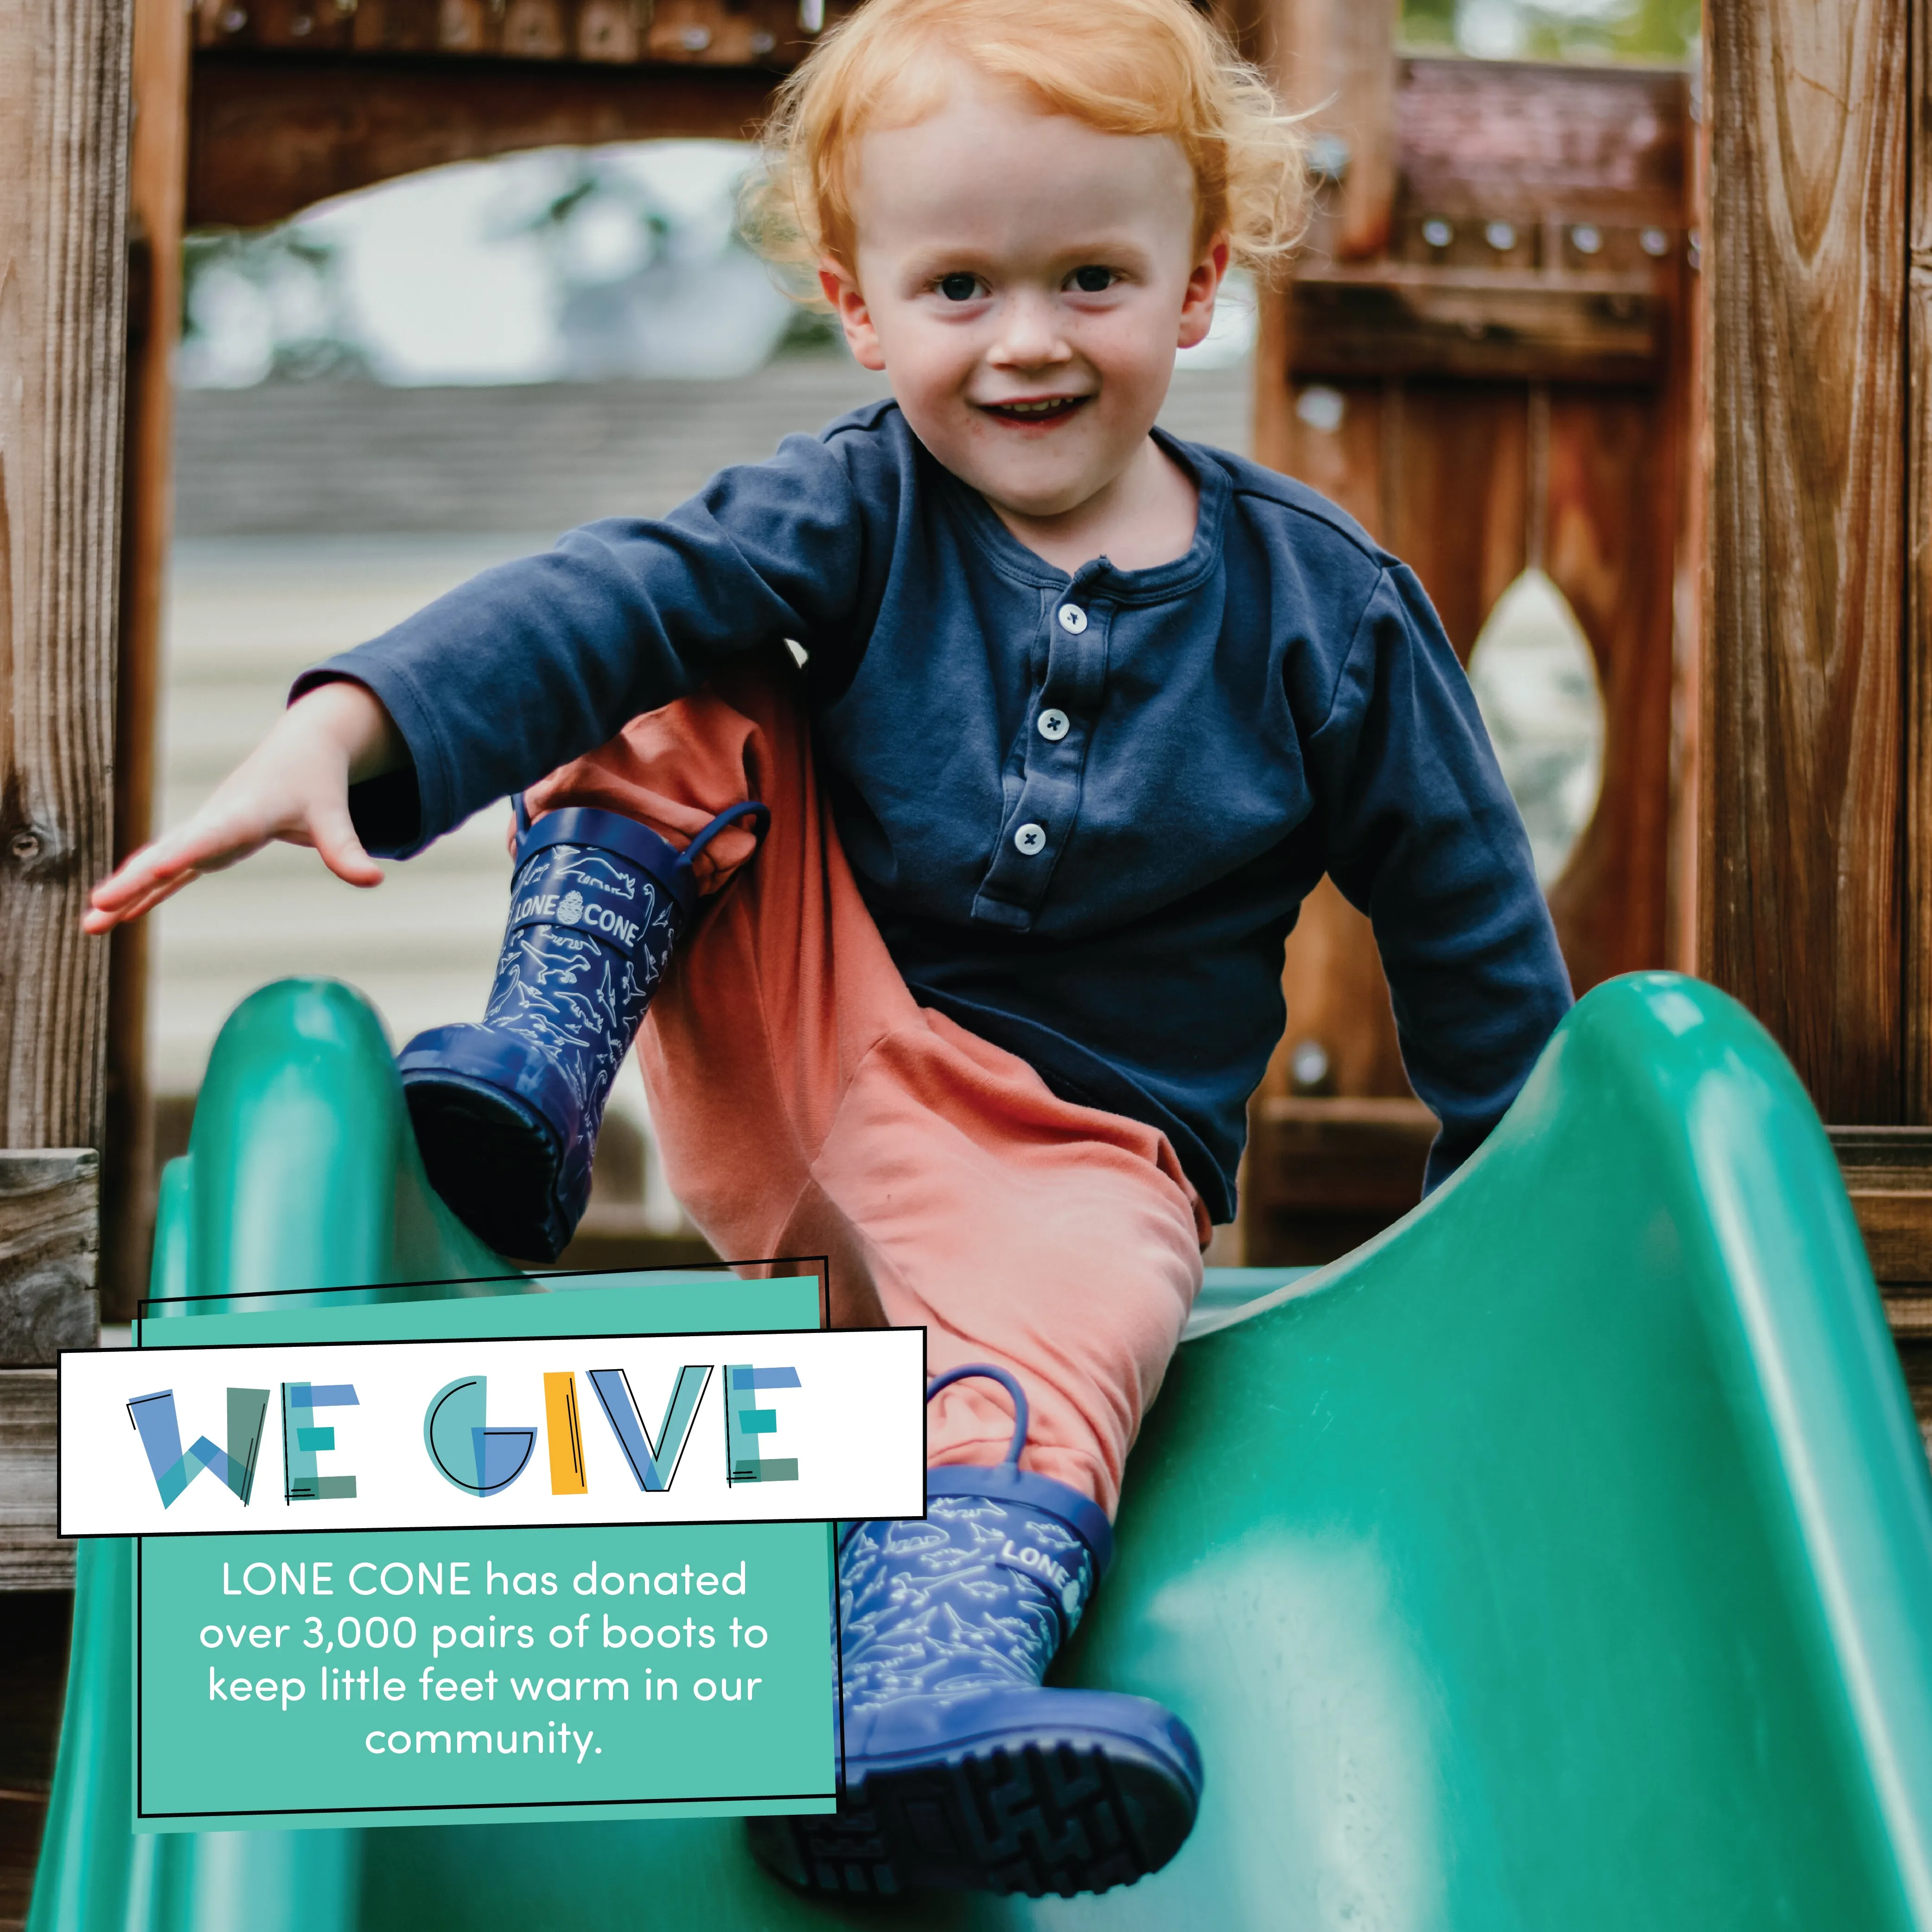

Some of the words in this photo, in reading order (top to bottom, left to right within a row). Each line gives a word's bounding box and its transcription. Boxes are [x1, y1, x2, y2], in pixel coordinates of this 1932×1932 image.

[515, 895, 560, 923] LONE
[584, 904, 639, 947] CONE
[1002, 1539, 1070, 1591] LONE
